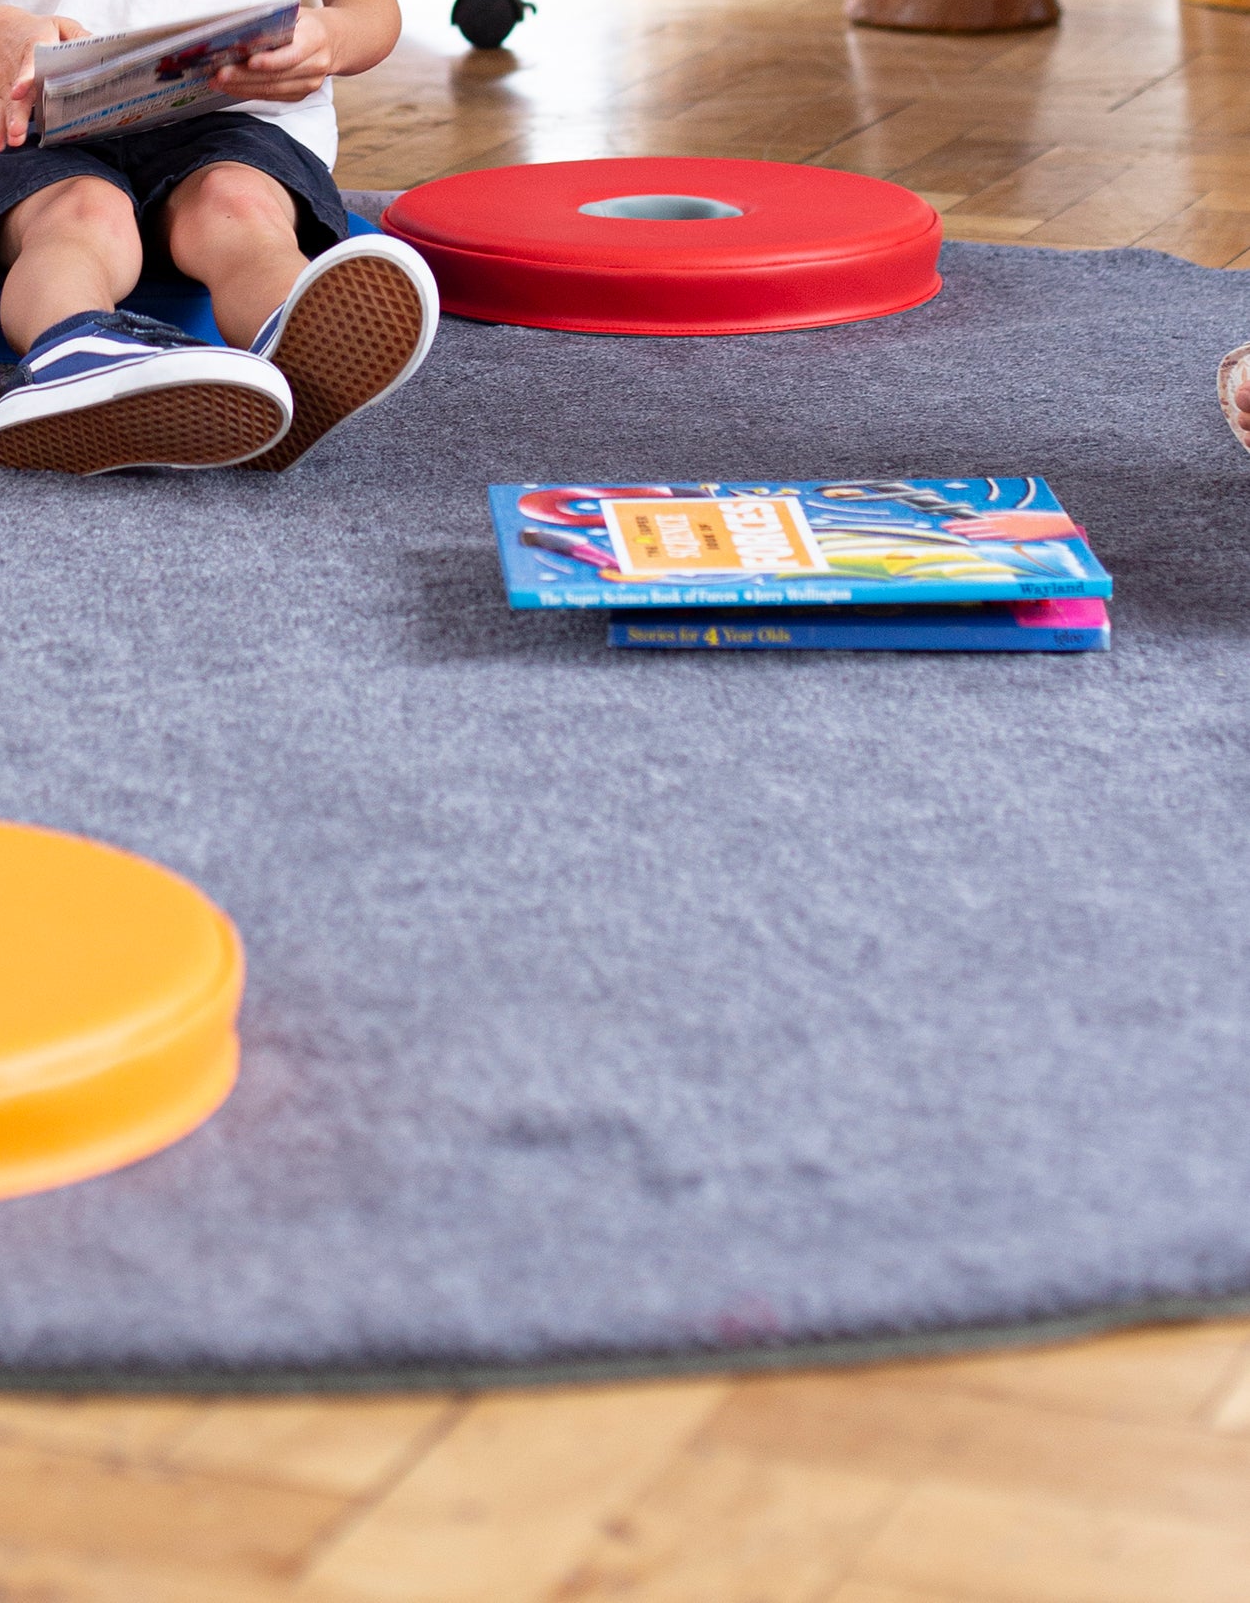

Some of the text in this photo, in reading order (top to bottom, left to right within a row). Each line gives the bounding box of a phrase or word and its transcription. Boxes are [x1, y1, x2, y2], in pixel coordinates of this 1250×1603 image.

[717, 501, 800, 570] FORCES
[1019, 581, 1086, 598] Wayland
[628, 626, 791, 646] Stories for 4 Year Olds
